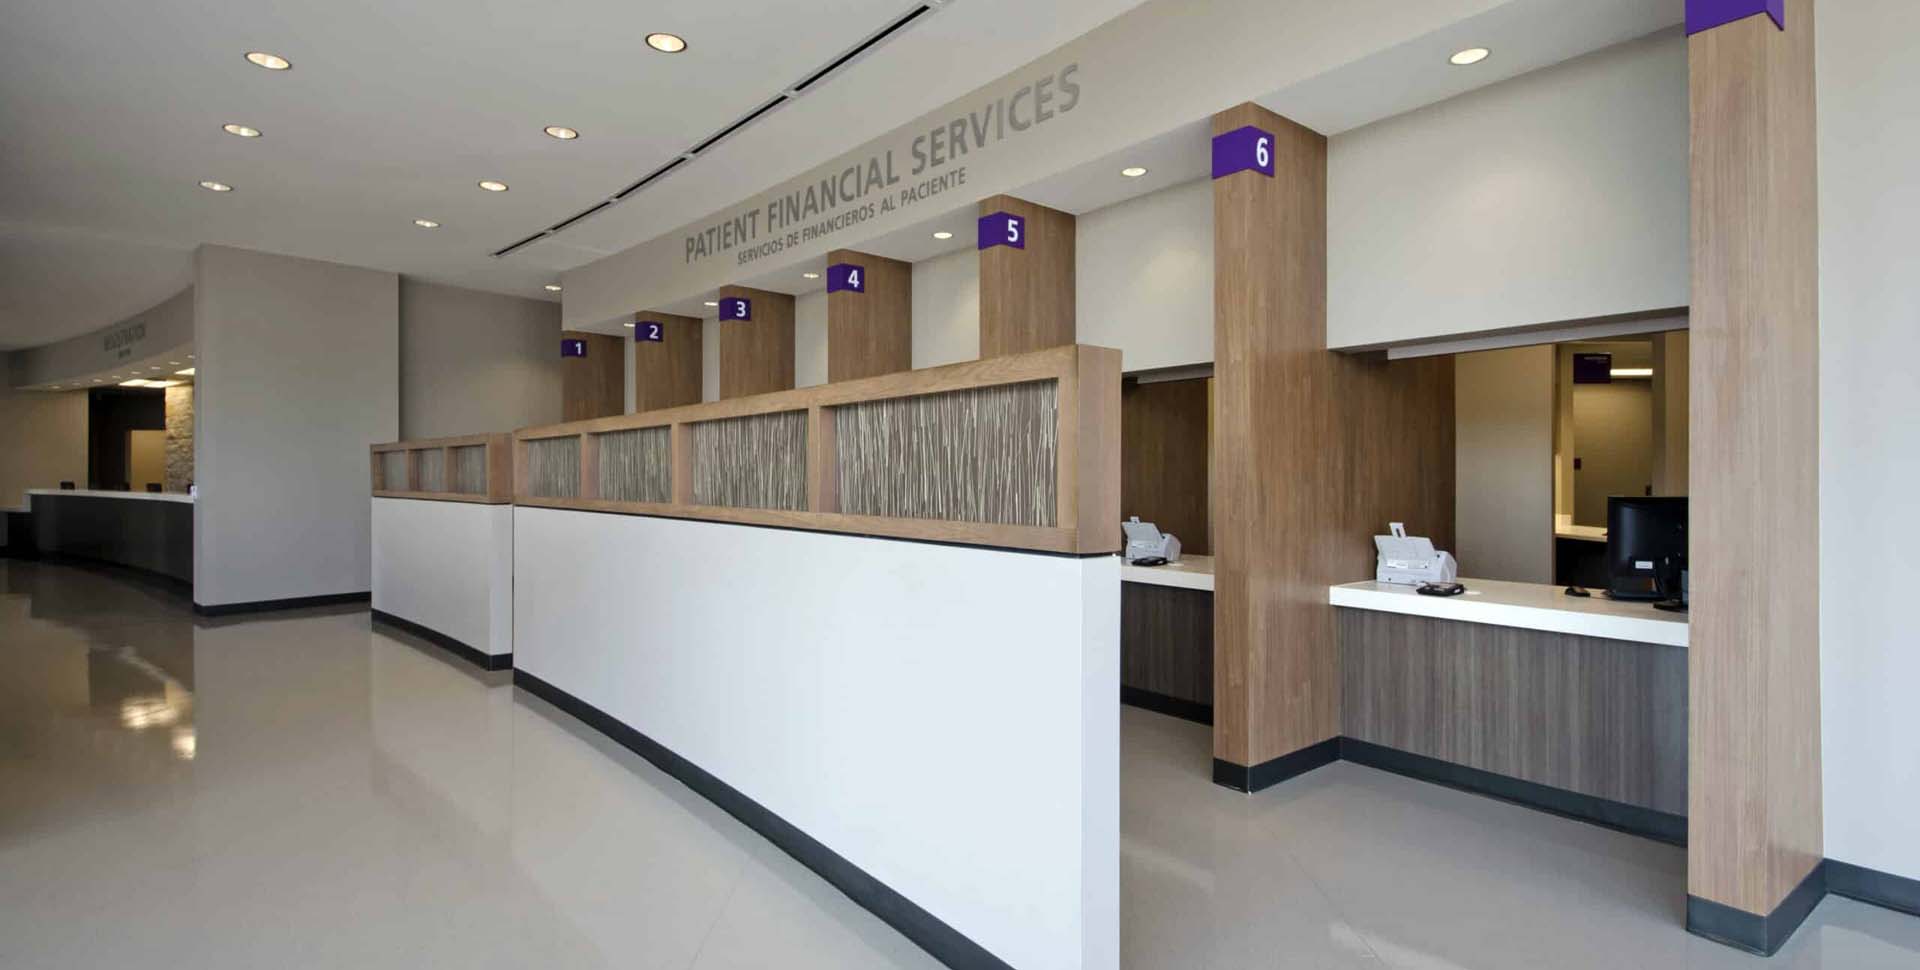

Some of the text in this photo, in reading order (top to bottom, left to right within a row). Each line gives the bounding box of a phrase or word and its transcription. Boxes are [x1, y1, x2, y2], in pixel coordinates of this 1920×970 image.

[1256, 137, 1268, 167] 6
[685, 63, 1080, 264] PATIENT FINANCIAL SERVICES
[737, 166, 967, 265] SERVICIOS DE FINANCIEROS AL PACIENTE
[1007, 219, 1018, 242] 5
[848, 269, 859, 287] 4
[736, 301, 746, 317] 3
[649, 325, 658, 339] 2
[575, 342, 581, 355] 1
